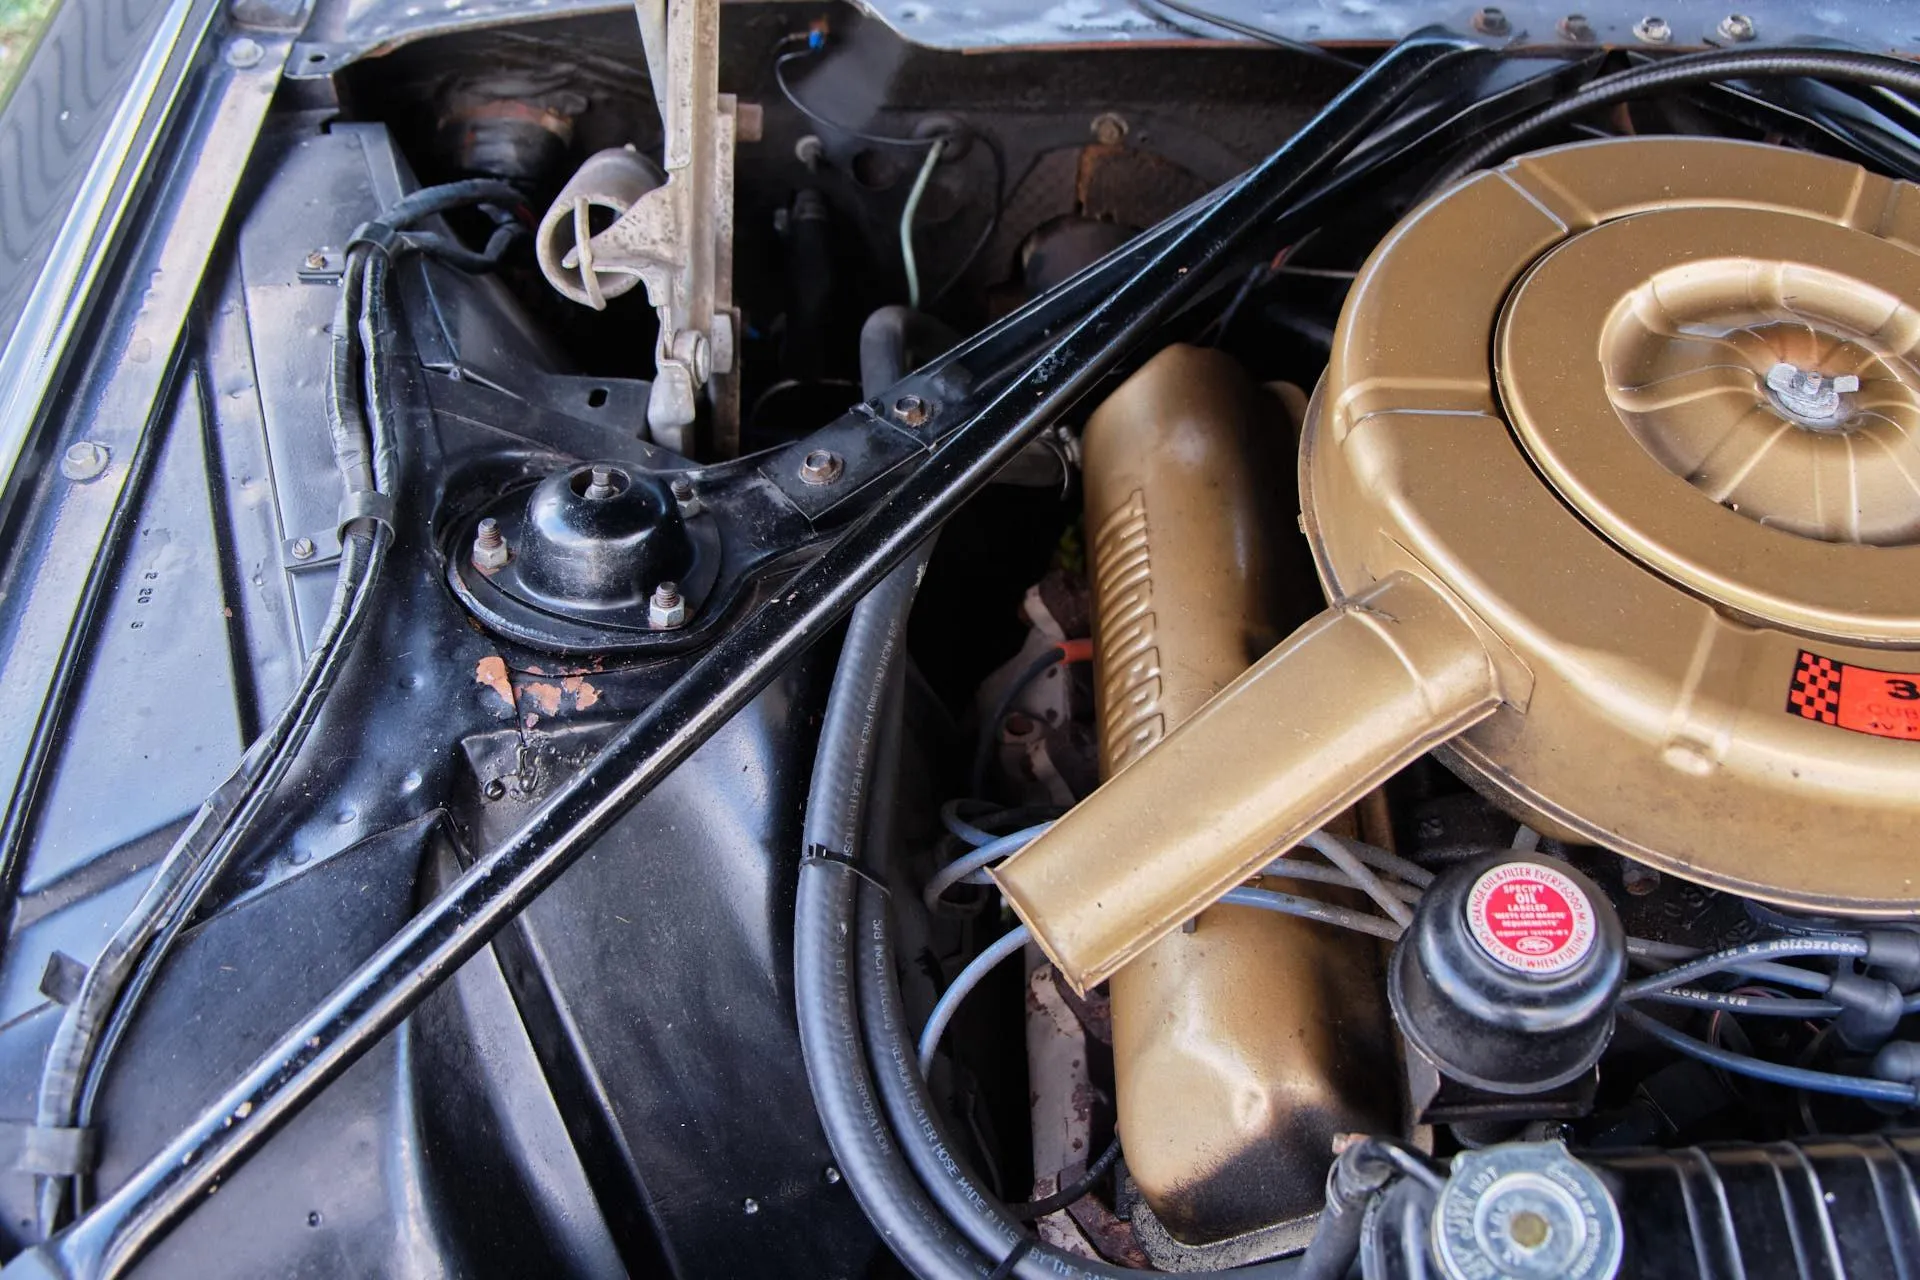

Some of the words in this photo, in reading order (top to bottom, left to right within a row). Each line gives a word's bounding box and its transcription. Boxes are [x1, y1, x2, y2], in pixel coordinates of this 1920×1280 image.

[1885, 678, 1920, 700] 3
[1472, 890, 1487, 928] CHANGE
[1483, 877, 1498, 890] OIL
[1534, 868, 1561, 887] EVERY
[1560, 884, 1583, 910] 6000
[1502, 884, 1545, 894] SPECIFY
[1515, 893, 1537, 904] OIL
[1507, 904, 1548, 912] LABELED
[1479, 931, 1505, 956] CHECK
[1506, 954, 1524, 966] OIL
[1526, 958, 1559, 969] WHEN
[1770, 938, 1858, 953] PROTECTION
[1717, 994, 1749, 1007] MAX
[852, 1064, 892, 1157] CORPORATION
[906, 1090, 939, 1142] HEATER
[931, 1142, 962, 1178] HOSE
[956, 1175, 985, 1214] MADE
[1029, 1246, 1048, 1265] BY
[1052, 1257, 1078, 1278] THE
